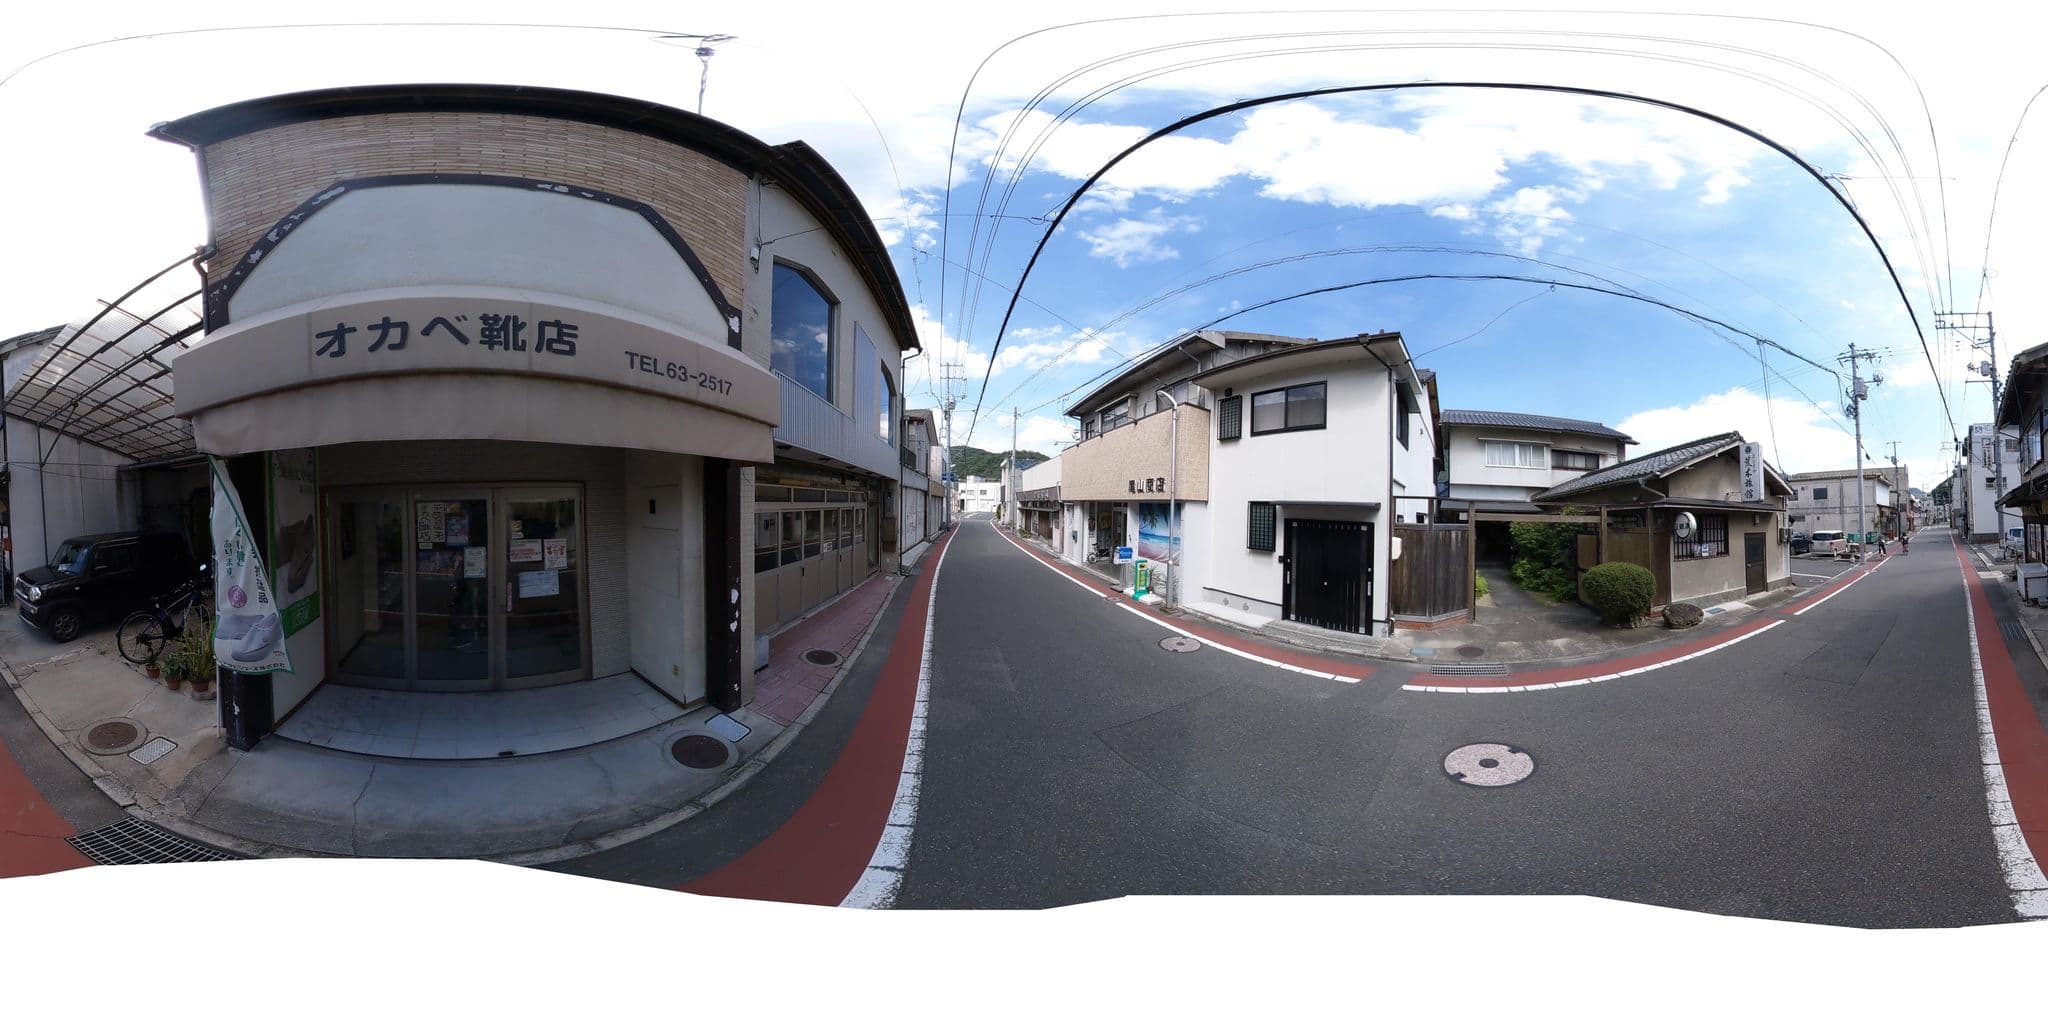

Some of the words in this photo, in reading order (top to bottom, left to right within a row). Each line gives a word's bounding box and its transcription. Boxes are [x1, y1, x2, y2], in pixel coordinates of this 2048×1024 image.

[315, 313, 579, 358] オカベ靴店
